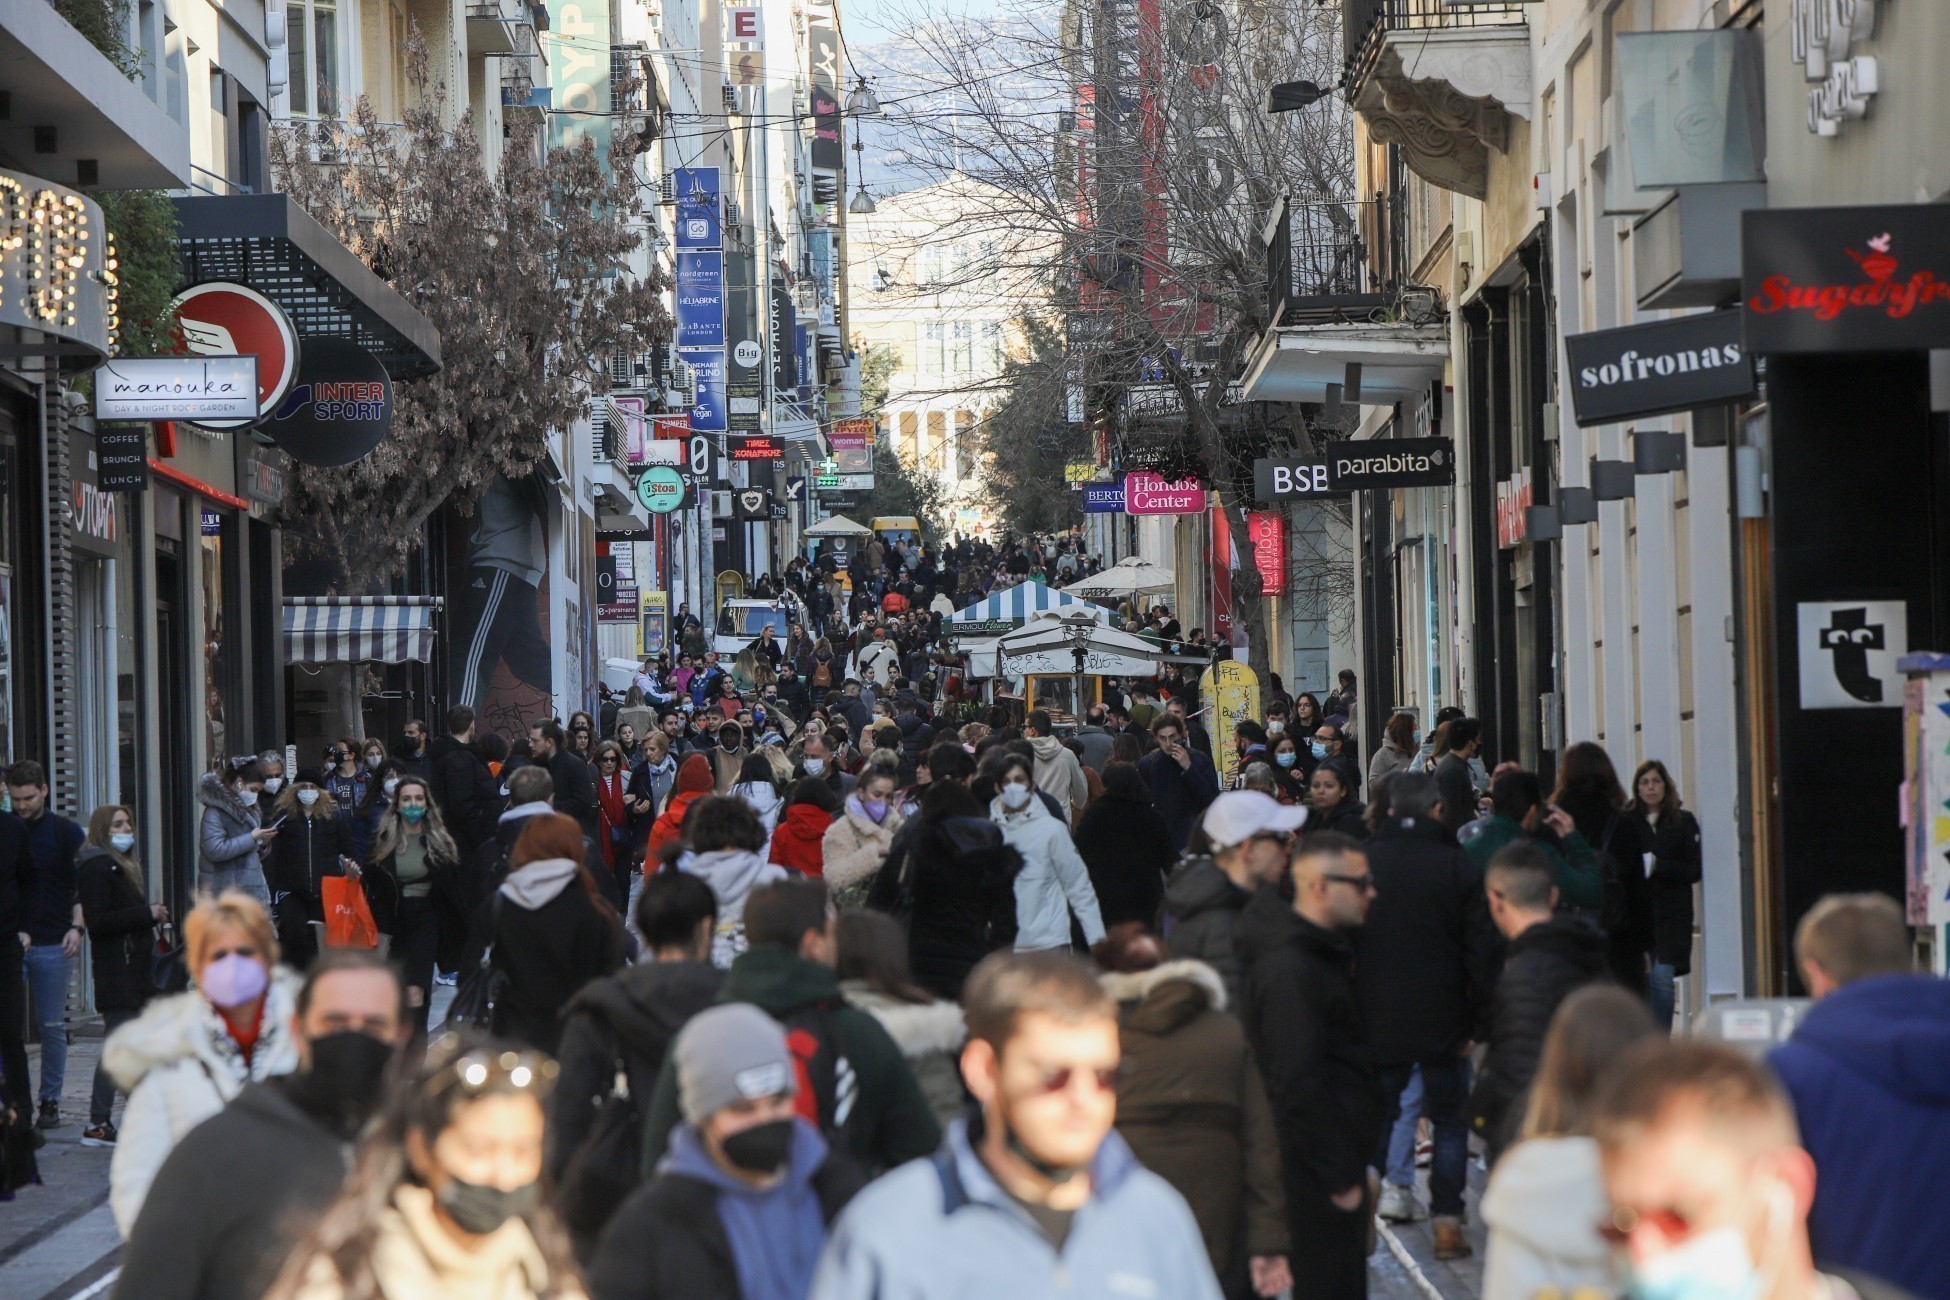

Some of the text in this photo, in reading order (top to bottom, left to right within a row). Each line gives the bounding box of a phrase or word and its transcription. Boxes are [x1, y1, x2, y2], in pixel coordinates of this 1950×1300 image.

[679, 270, 719, 278] nordgreen
[771, 298, 781, 373] SEPHORA
[738, 347, 758, 360] Big
[1581, 341, 1742, 389] sofronas
[114, 362, 240, 397] manouka
[696, 369, 721, 377] RLIND
[314, 381, 384, 402] INTER
[114, 403, 236, 413] DAY & NIGHT ROOF GARDEN
[314, 400, 384, 421] SPORT
[101, 434, 139, 444] COFFEE
[103, 455, 141, 464] BRUNCH
[773, 459, 785, 468] hs
[1337, 452, 1430, 479] parabita
[104, 475, 142, 485] LUNCH
[1133, 476, 1198, 493] Hondos
[1273, 464, 1328, 494] BSB
[647, 483, 676, 493] iStoa
[1134, 492, 1192, 509] Center
[952, 623, 984, 631] ERMOU
